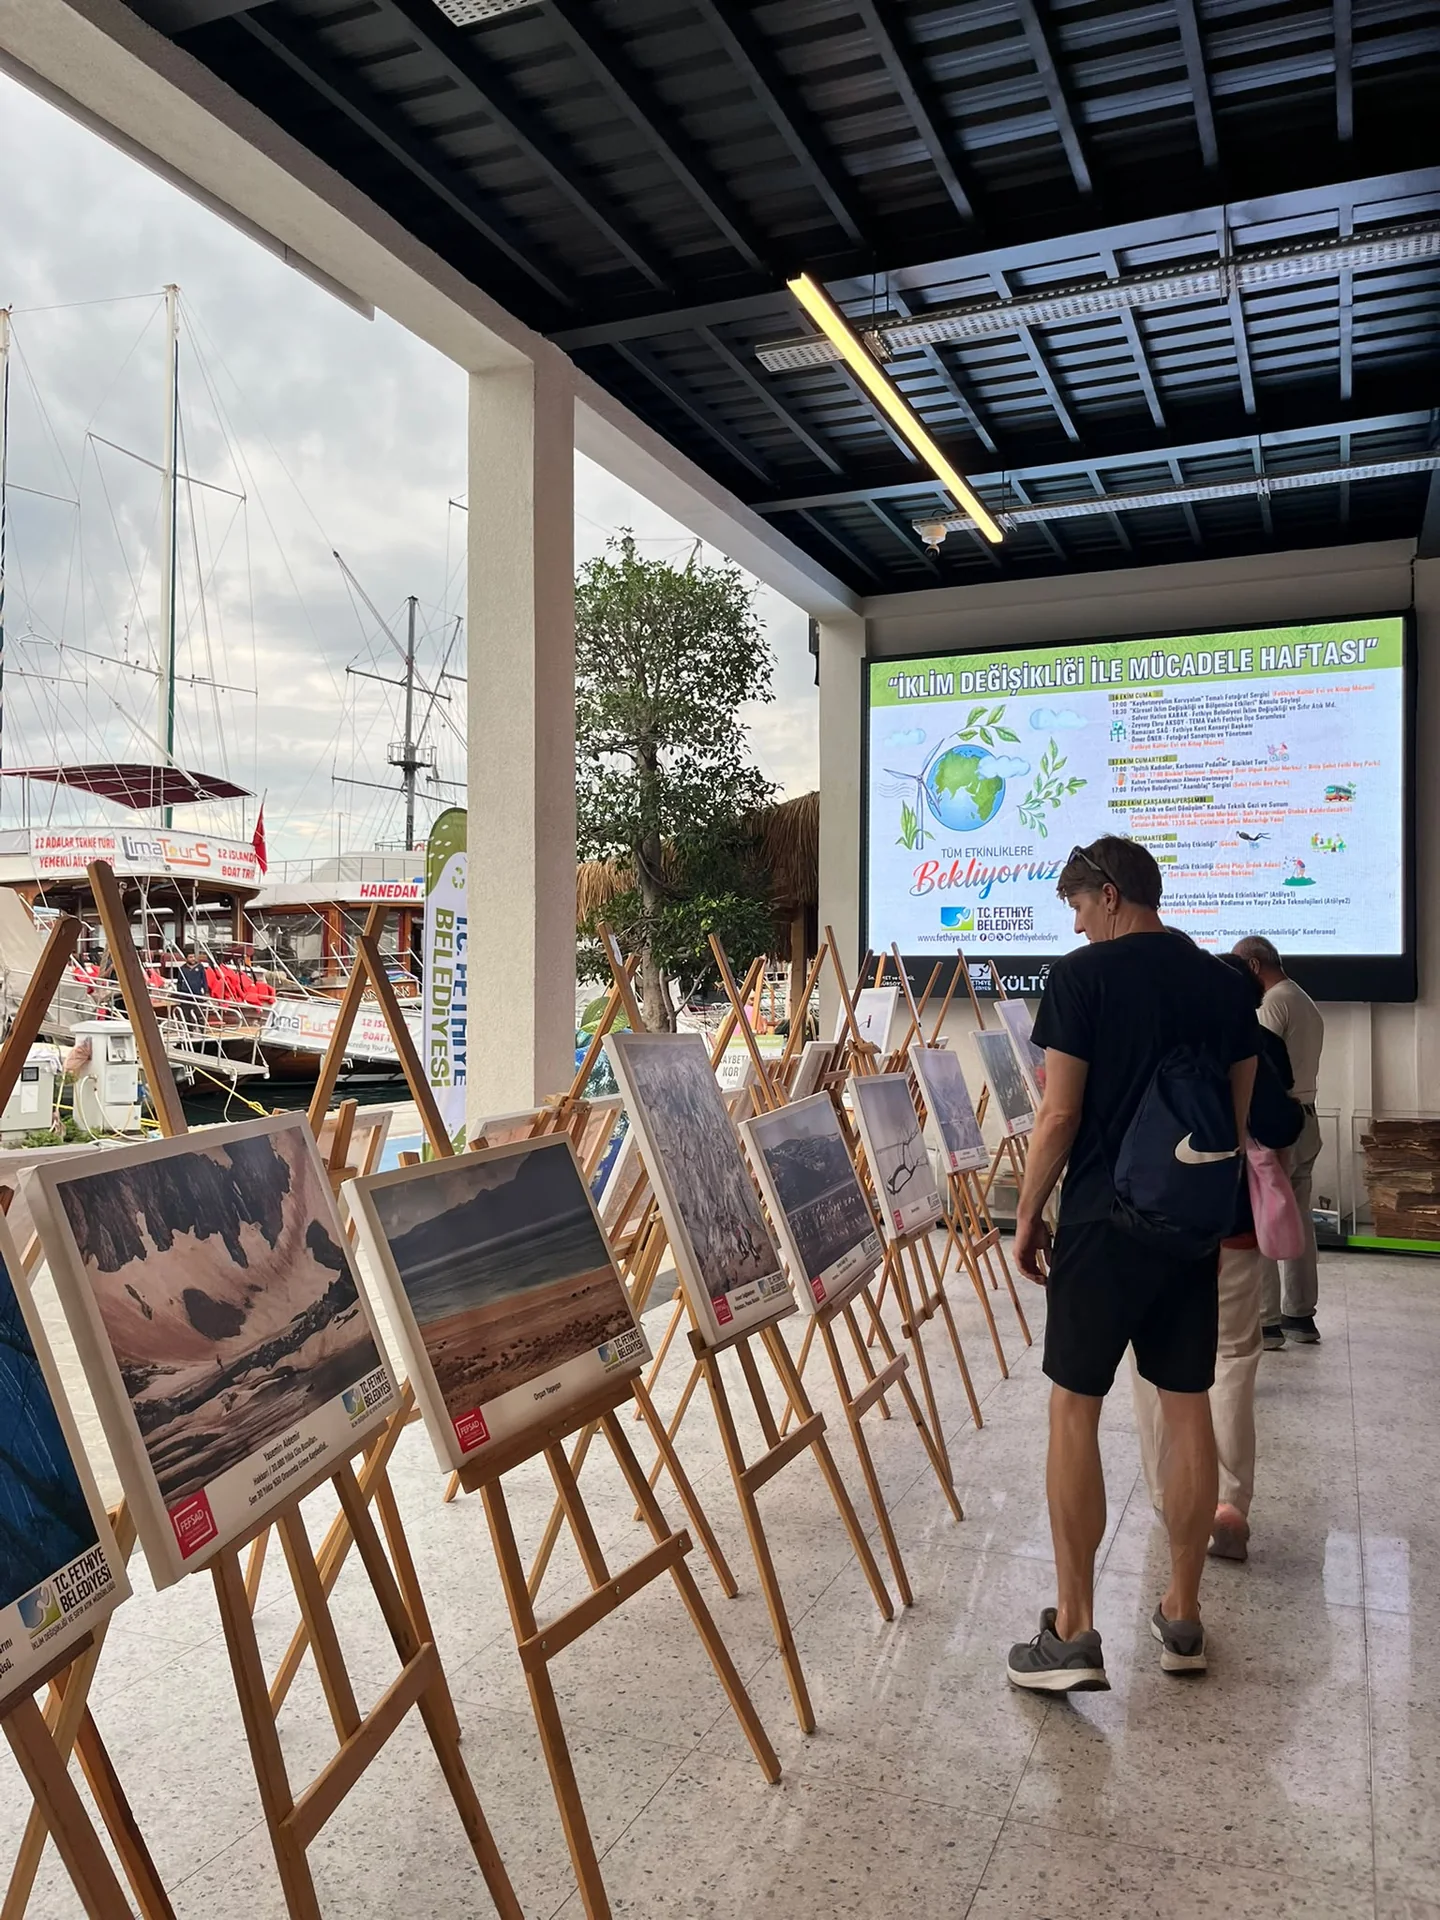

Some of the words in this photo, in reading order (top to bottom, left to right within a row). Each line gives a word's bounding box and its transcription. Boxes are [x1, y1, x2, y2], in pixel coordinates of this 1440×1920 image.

[960, 656, 1085, 697] DEĞİŞİKLİĞİ
[1091, 655, 1123, 683] İLE
[1129, 646, 1254, 681] MÜCADELE
[36, 838, 44, 849] 12
[46, 836, 74, 848] ADALAR
[75, 837, 96, 848] TEKNE
[98, 837, 115, 848] TURU
[218, 848, 226, 858] 12
[941, 846, 962, 858] TÜM
[966, 845, 1033, 858] ETKİNLİKLERE
[40, 853, 71, 868] YEMEKLİ
[73, 853, 87, 867] AİLE
[222, 866, 240, 877] BOAT
[910, 858, 1067, 899] Bekliyoruz
[360, 884, 418, 898] HANEDAN
[977, 907, 992, 918] T.C.
[918, 934, 977, 943] www.fethiye.bel.tr
[1013, 933, 1058, 943] fethiyebelediye
[362, 1018, 372, 1028] 12
[363, 1032, 384, 1042] BOAT
[460, 1420, 479, 1436] FEFSAD
[263, 1443, 283, 1461] Yasemin
[283, 1430, 300, 1448] Aldemir
[180, 1509, 204, 1532] FEFSAD
[53, 1572, 71, 1593] T.C.
